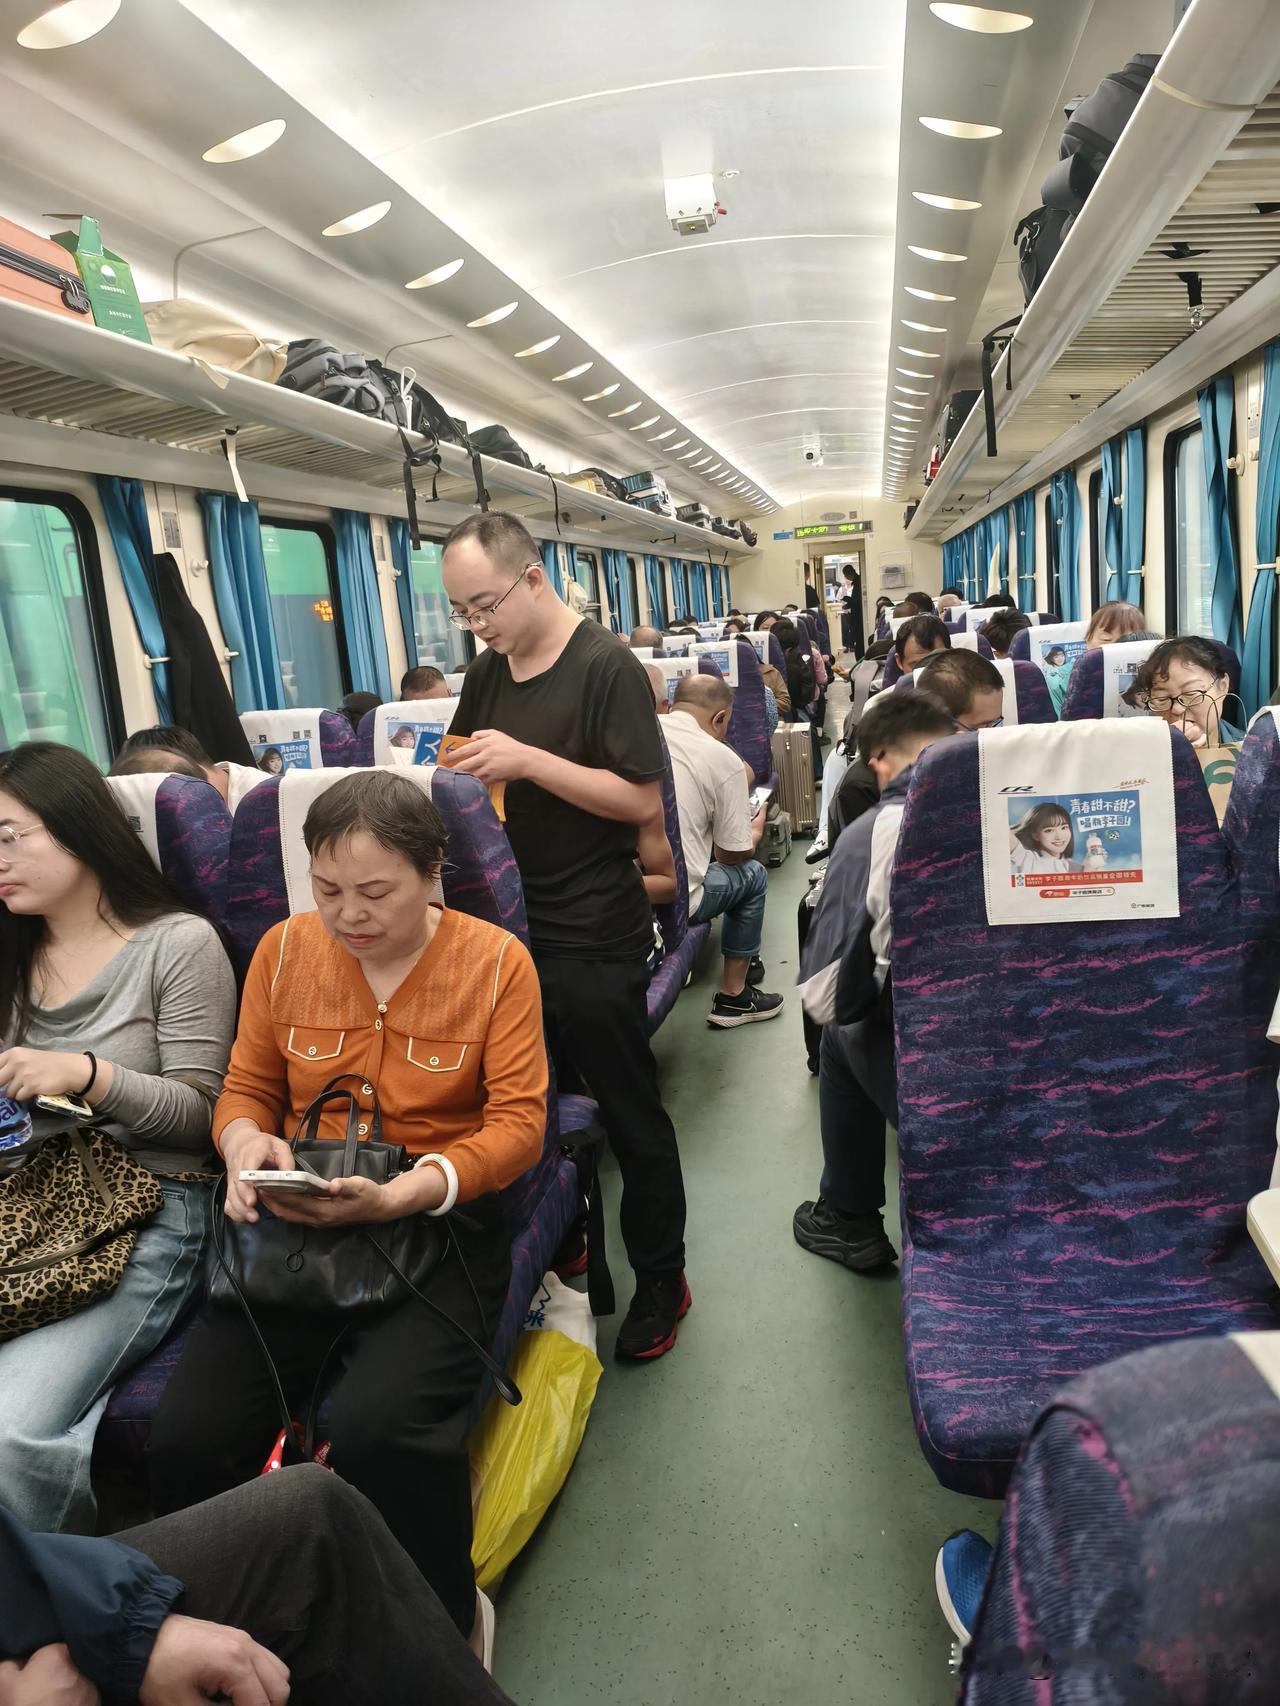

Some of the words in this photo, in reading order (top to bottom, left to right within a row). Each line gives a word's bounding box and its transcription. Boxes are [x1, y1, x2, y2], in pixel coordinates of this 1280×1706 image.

[1070, 798, 1136, 815] 青春甜不甜?
